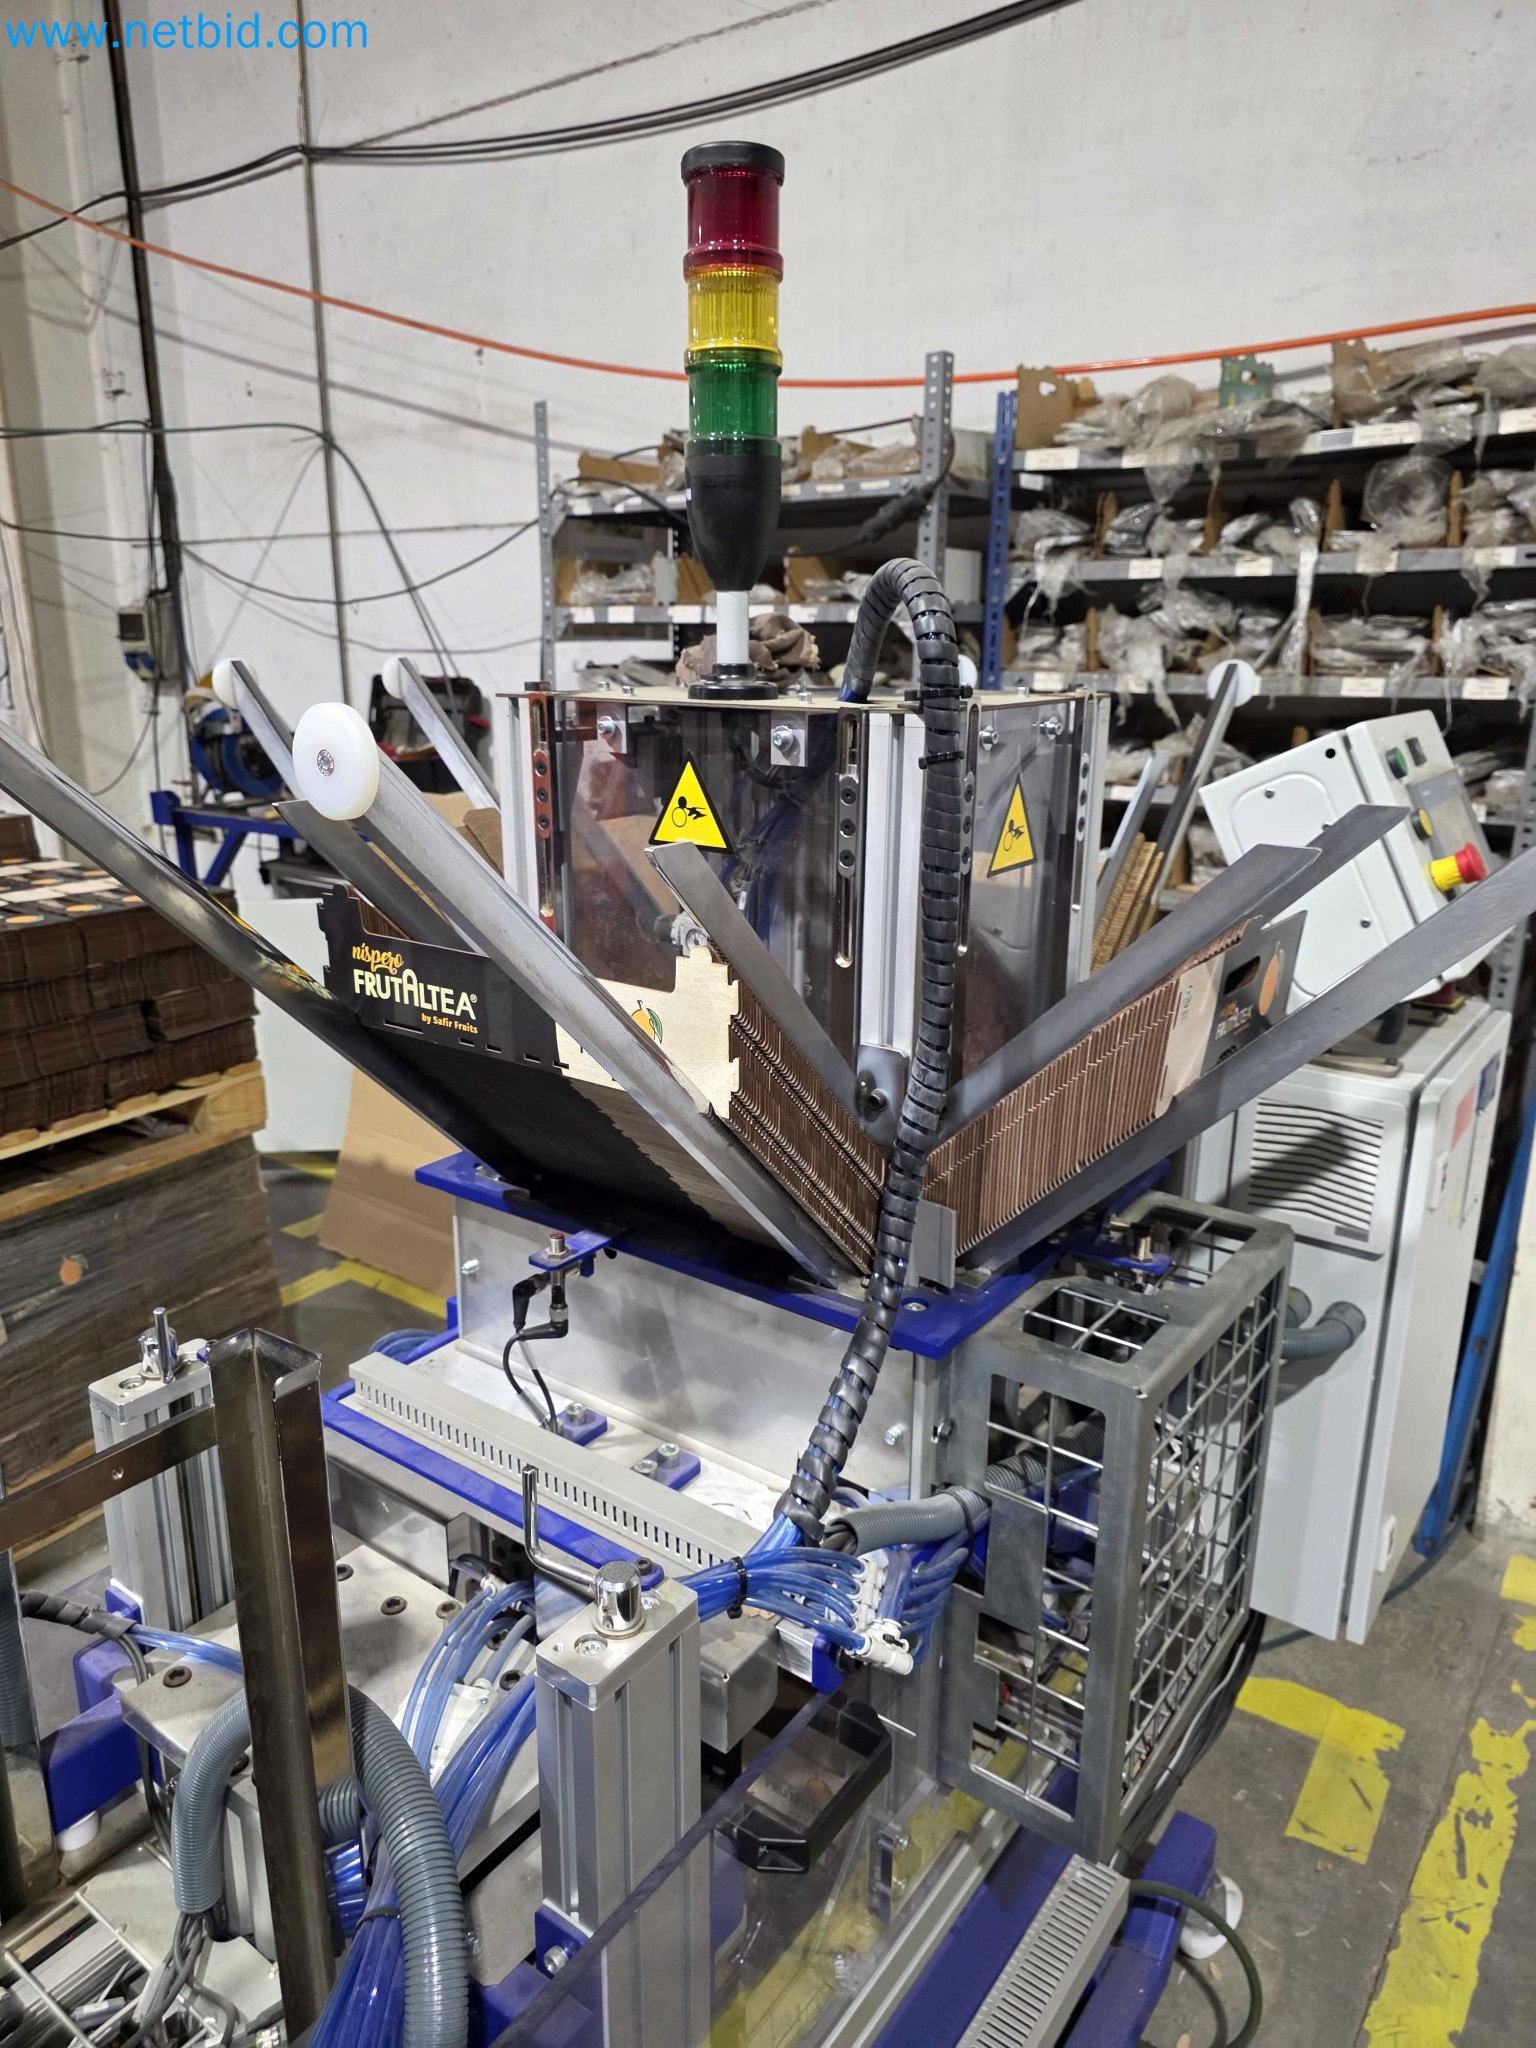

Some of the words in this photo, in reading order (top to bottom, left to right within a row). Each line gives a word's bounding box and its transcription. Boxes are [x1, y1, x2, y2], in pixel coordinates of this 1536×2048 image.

[421, 1013, 432, 1024] by
[433, 1016, 453, 1027] Safir
[454, 1021, 478, 1034] Fruits
